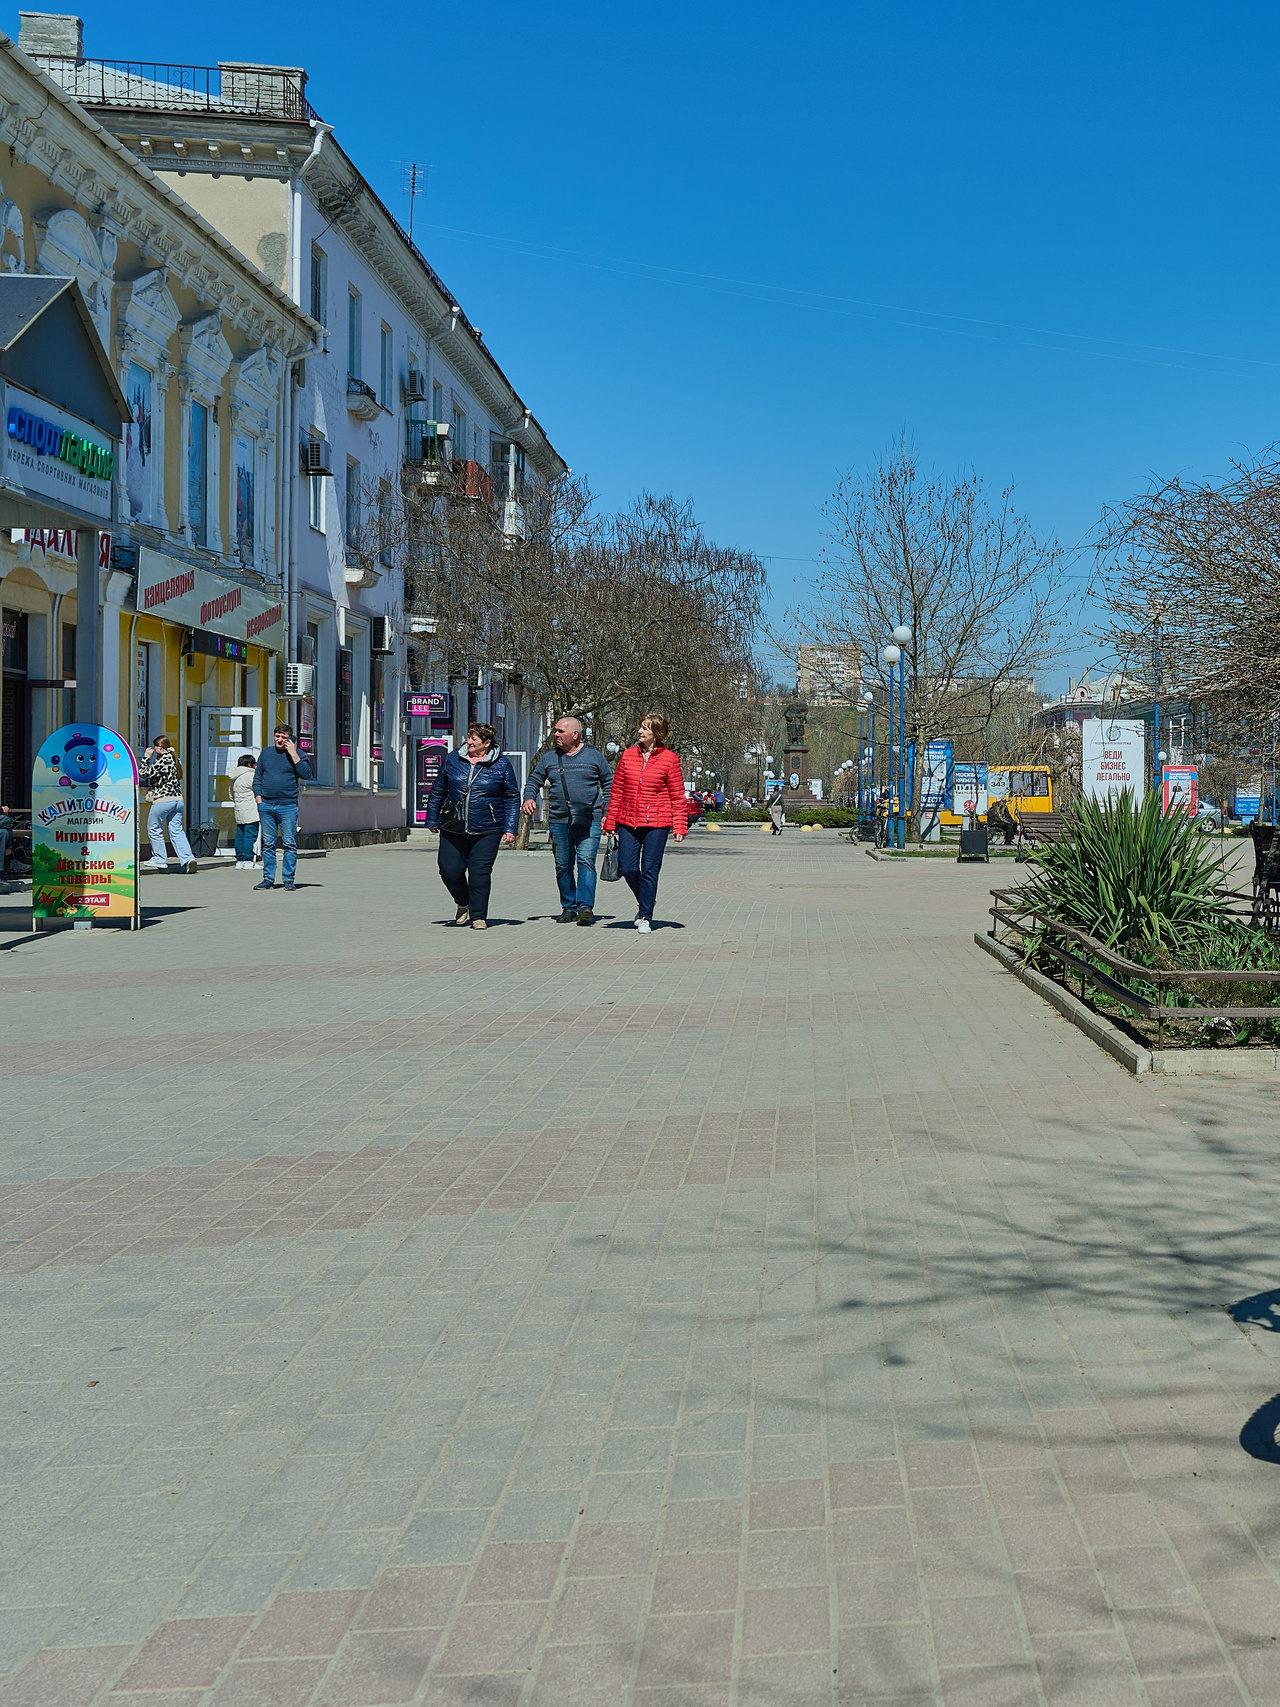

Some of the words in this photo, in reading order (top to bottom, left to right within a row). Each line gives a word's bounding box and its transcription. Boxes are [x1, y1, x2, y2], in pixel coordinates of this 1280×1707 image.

[7, 448, 34, 469] МЕРЕЖА
[37, 460, 76, 486] СПОРТИВНИХ
[1104, 750, 1123, 760] ВЕДИ
[1100, 761, 1126, 770] БИЗНЕС
[1096, 772, 1131, 781] ЛЕГАЛЬНО
[38, 798, 131, 826] КАПИТОШКА
[67, 816, 104, 825] МАГАЗИН
[55, 830, 115, 843] Игрушки
[81, 846, 90, 856] &
[56, 859, 115, 872] Детские
[59, 874, 112, 885] товары
[78, 896, 83, 904] 2
[84, 896, 107, 904] ЭТАЖ
